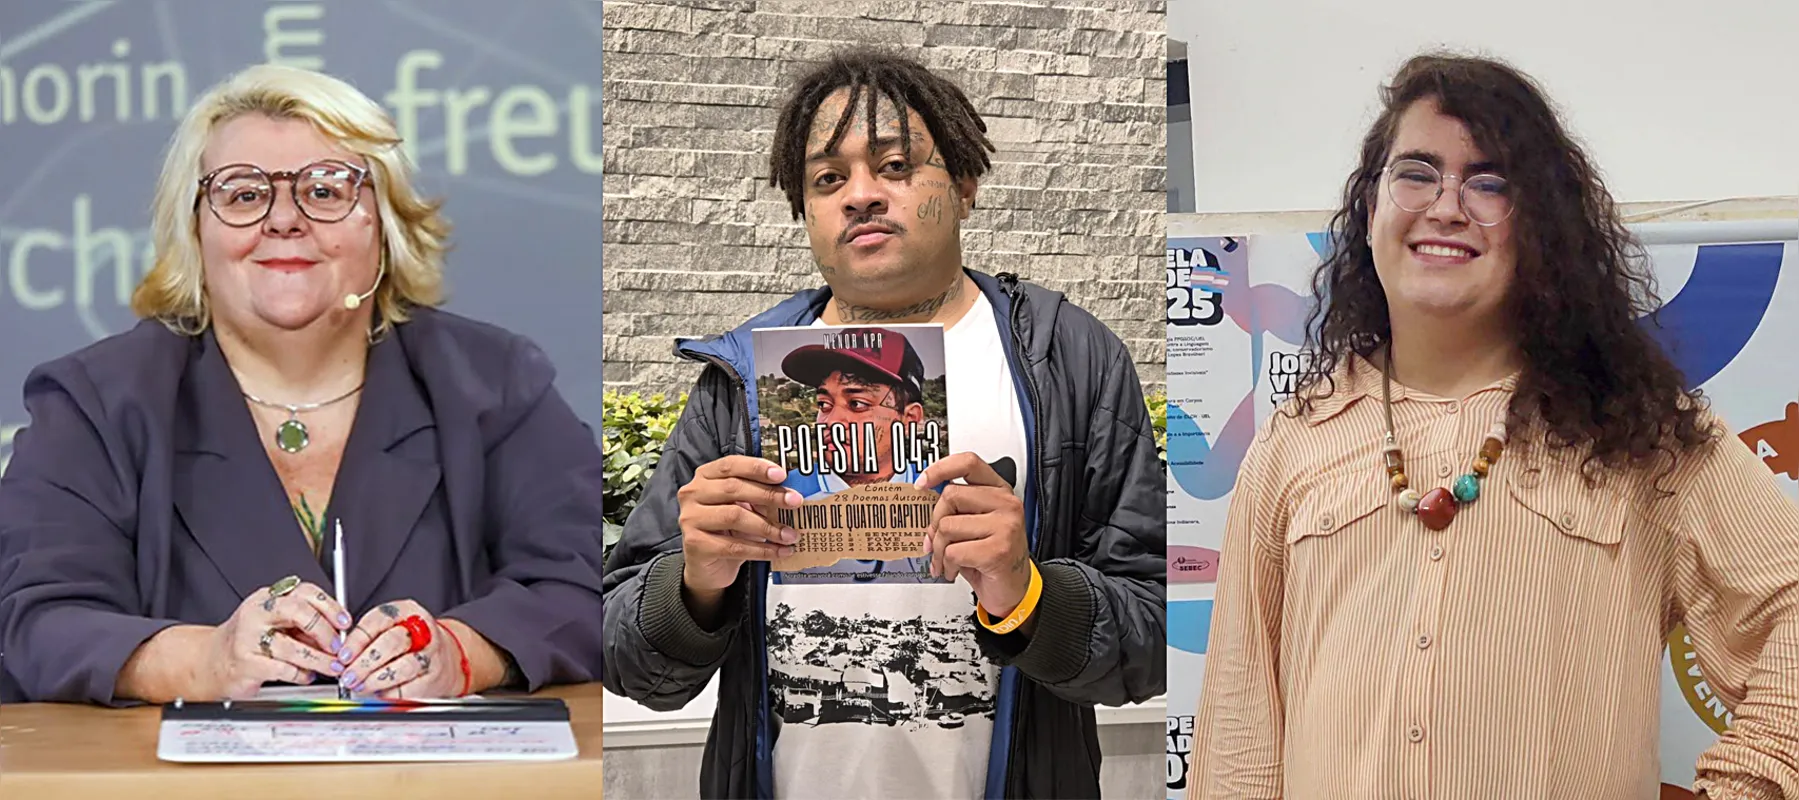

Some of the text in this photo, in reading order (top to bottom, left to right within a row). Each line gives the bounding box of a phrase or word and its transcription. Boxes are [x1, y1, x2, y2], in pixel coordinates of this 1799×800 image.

[1167, 287, 1216, 320] 25
[823, 333, 857, 350] MENOR
[777, 420, 940, 476] POESIA 043
[834, 493, 937, 502] 28 Poemas Autorais
[864, 484, 902, 492] Contém
[798, 504, 828, 530] LIVRO
[830, 504, 844, 529] DE
[846, 503, 888, 532] QUATRO
